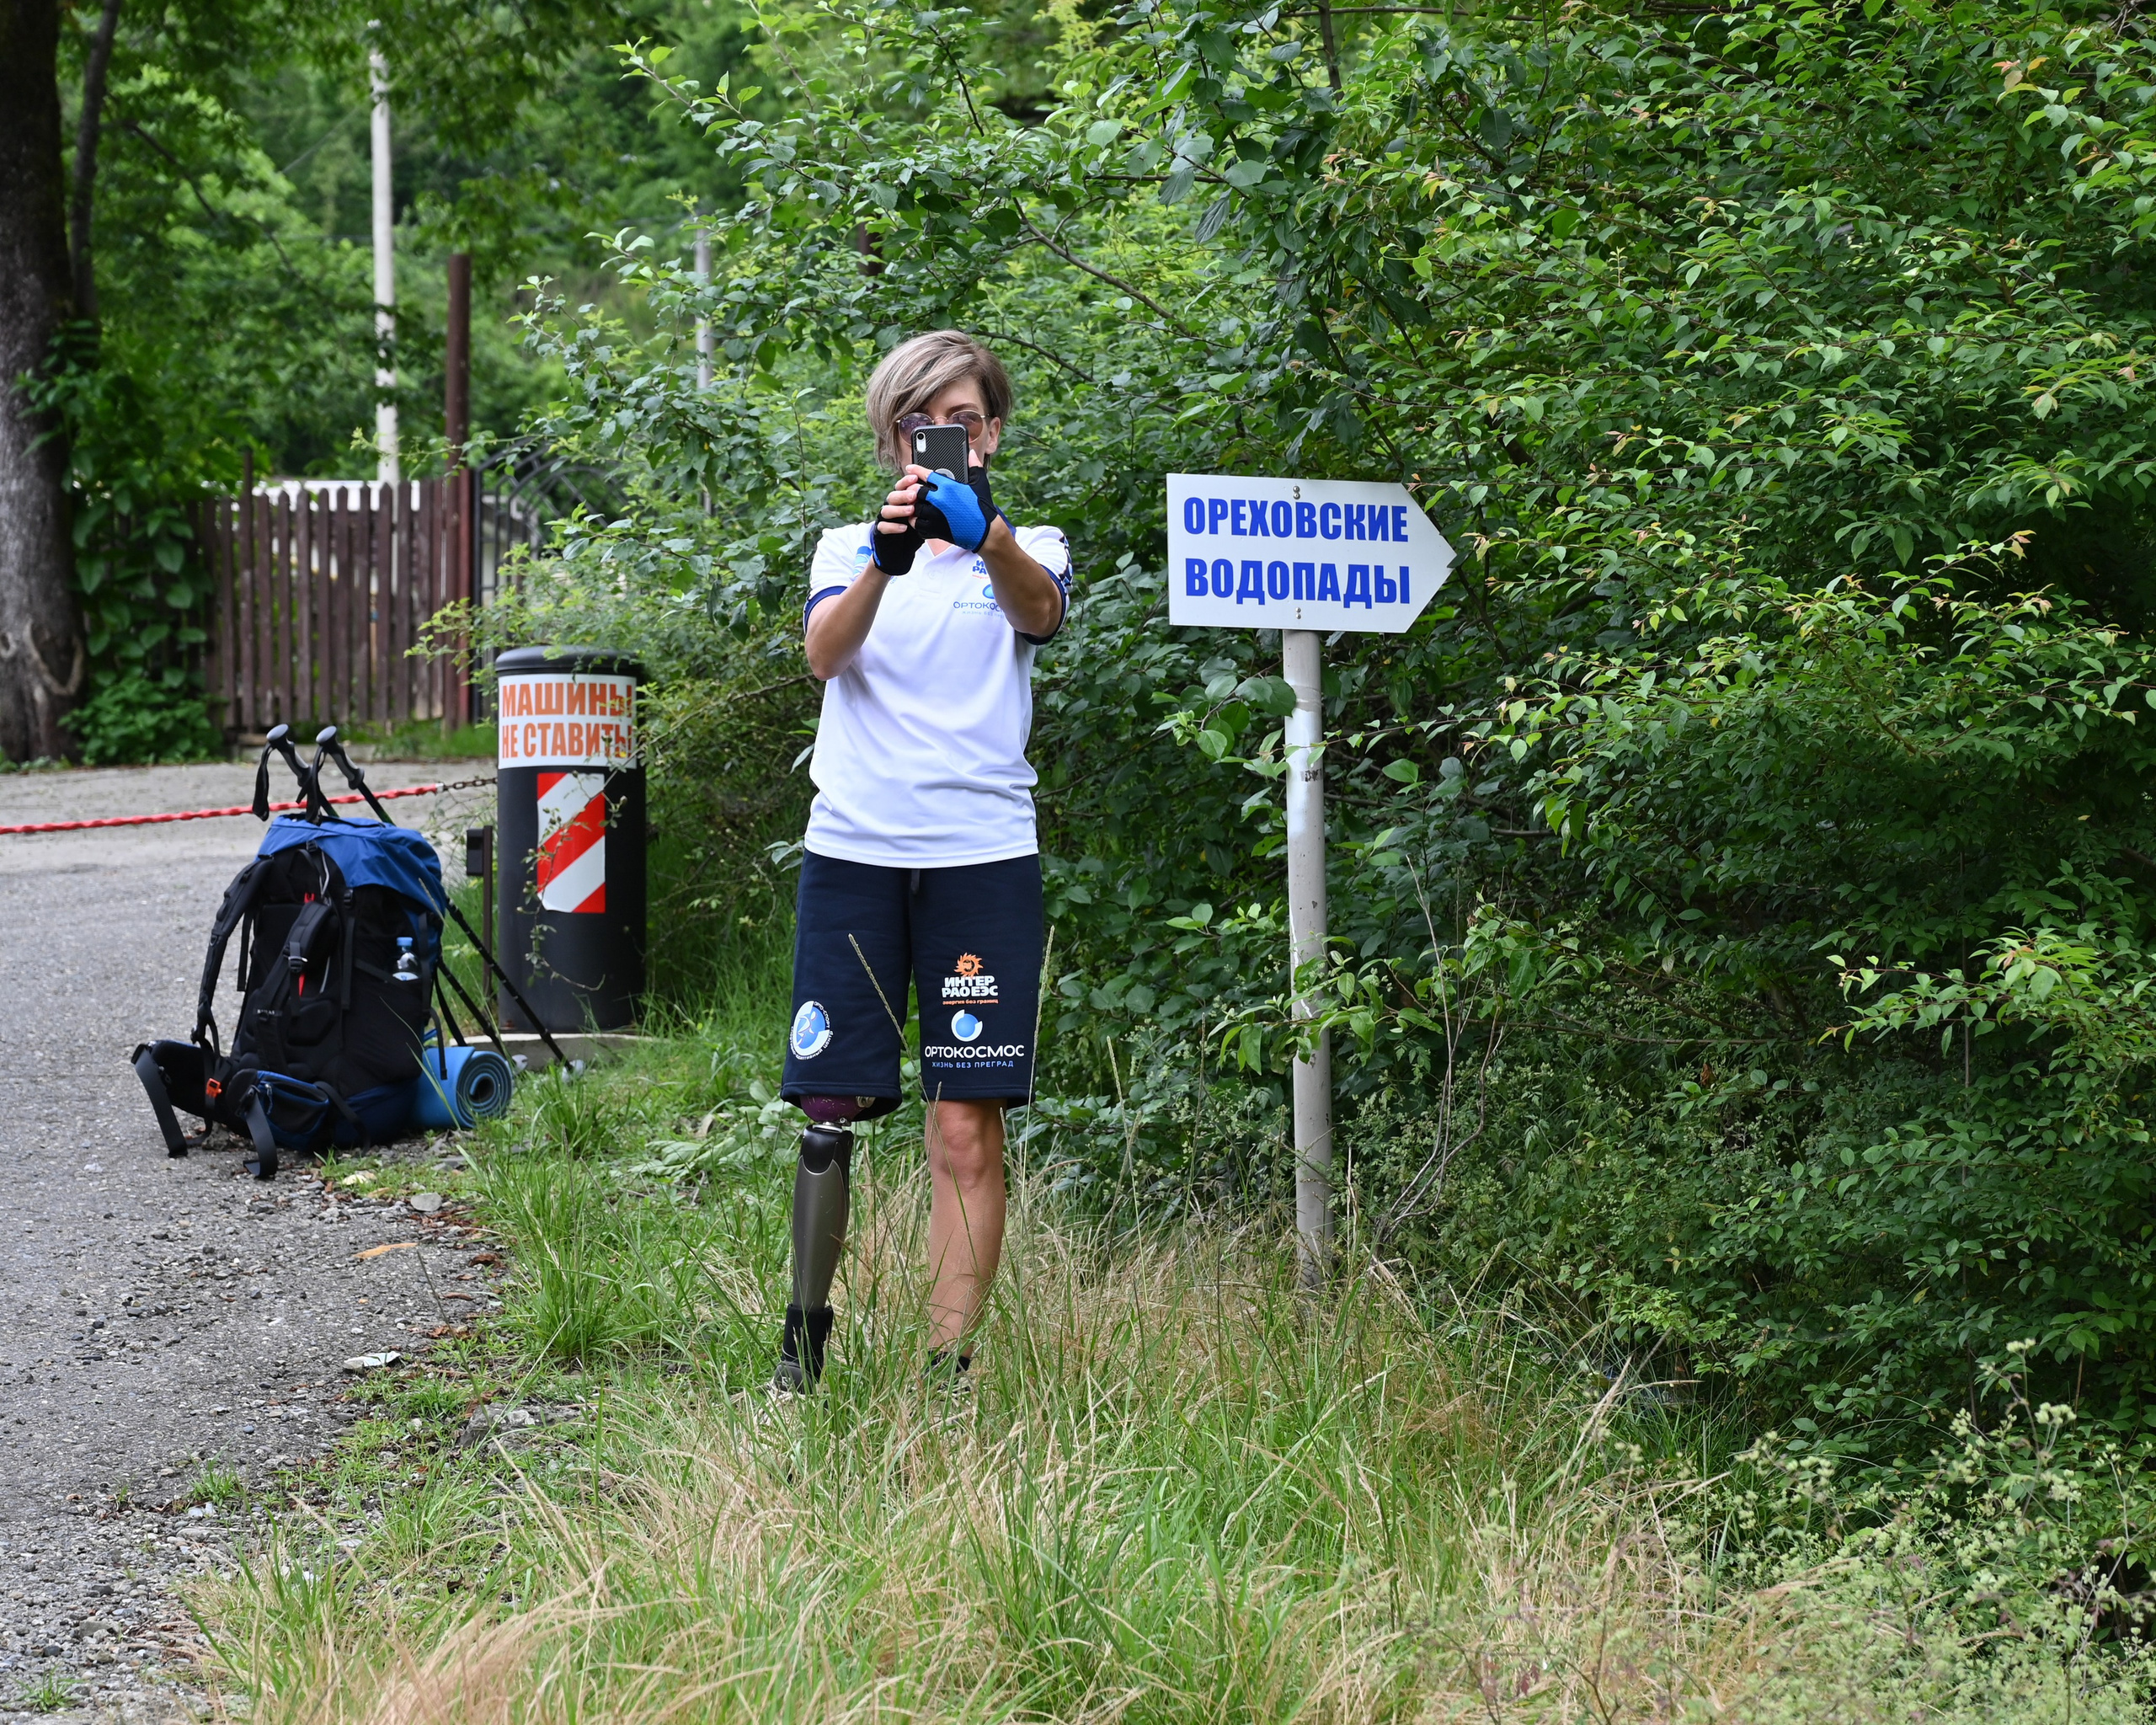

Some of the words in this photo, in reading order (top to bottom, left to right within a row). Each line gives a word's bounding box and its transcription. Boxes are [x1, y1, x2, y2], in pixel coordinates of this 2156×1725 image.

[1183, 496, 1409, 542] ОРЕХОВСКИЕ
[1185, 558, 1410, 609] ВОДОПАДЫ
[953, 601, 1002, 612] ОРТОКОС
[502, 681, 632, 718] МАШИНЫ
[502, 724, 518, 758] НЕ
[944, 975, 995, 987] ИНТЕР
[925, 1044, 1025, 1059] ОРТОКОСМОС
